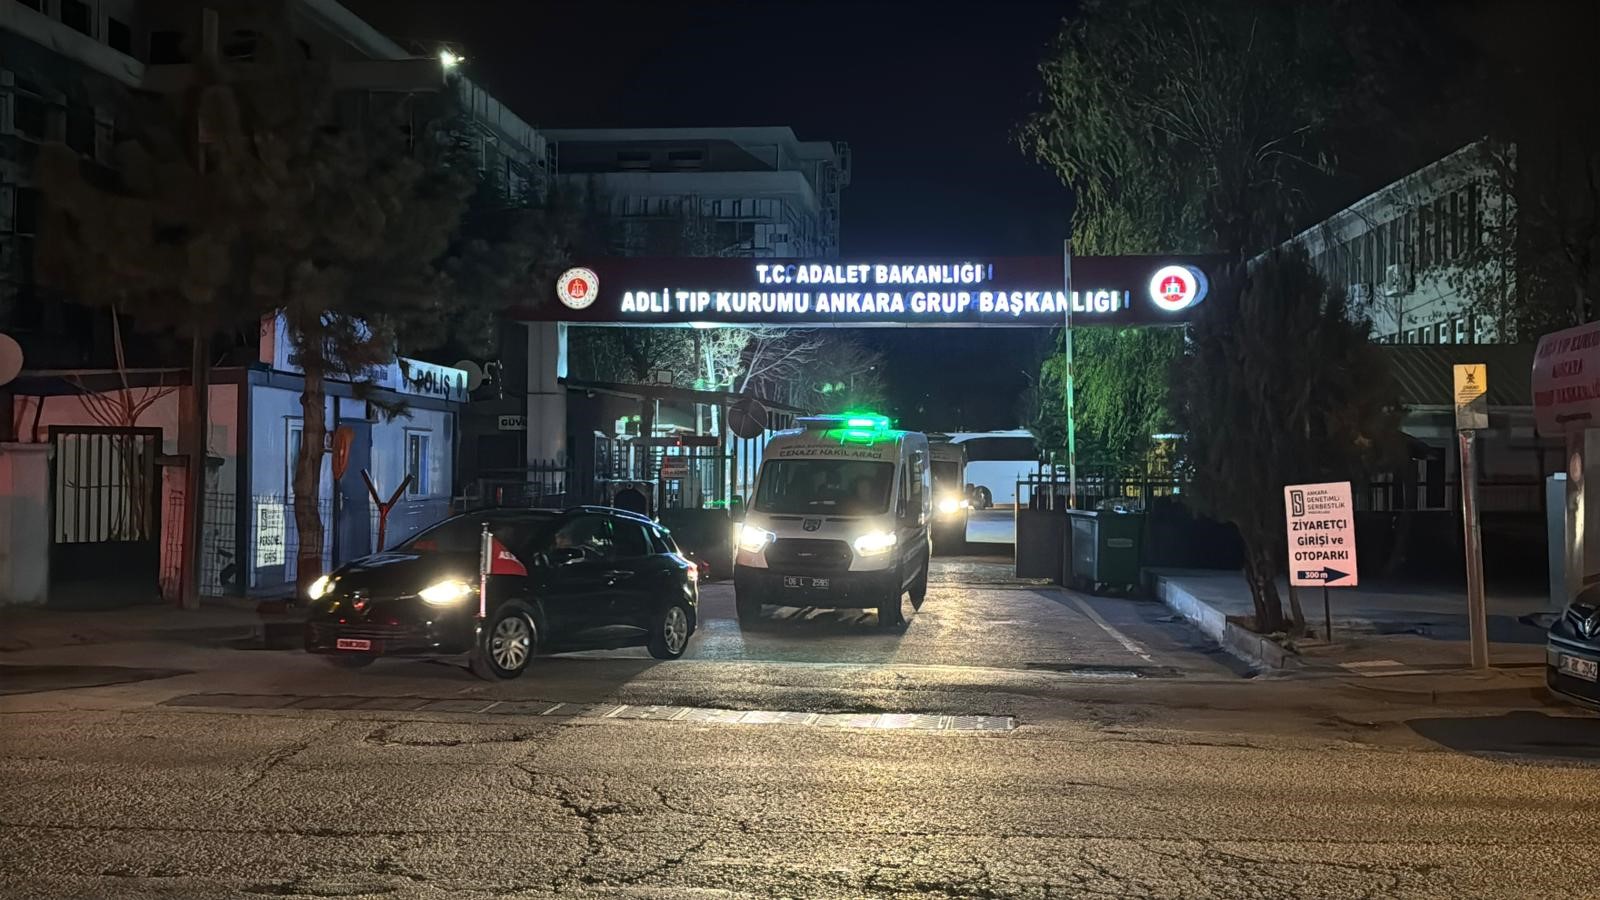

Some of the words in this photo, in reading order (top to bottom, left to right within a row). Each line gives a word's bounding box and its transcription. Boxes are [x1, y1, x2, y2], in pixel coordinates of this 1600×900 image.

[755, 263, 791, 284] T.C.
[797, 264, 871, 284] ADALET
[875, 261, 982, 284] BAKANLIĞI
[620, 288, 670, 313] ADLİ
[675, 291, 711, 313] TIP
[714, 292, 810, 313] KURUMU
[815, 292, 905, 313] ANKARA
[910, 291, 971, 313] GRUP
[978, 289, 1119, 317] BAŞKANLIĞI
[1297, 533, 1329, 548] GİRİŞİ
[1331, 537, 1344, 545] ve
[1294, 551, 1349, 562] OTOPARKI
[1304, 571, 1320, 580] 300
